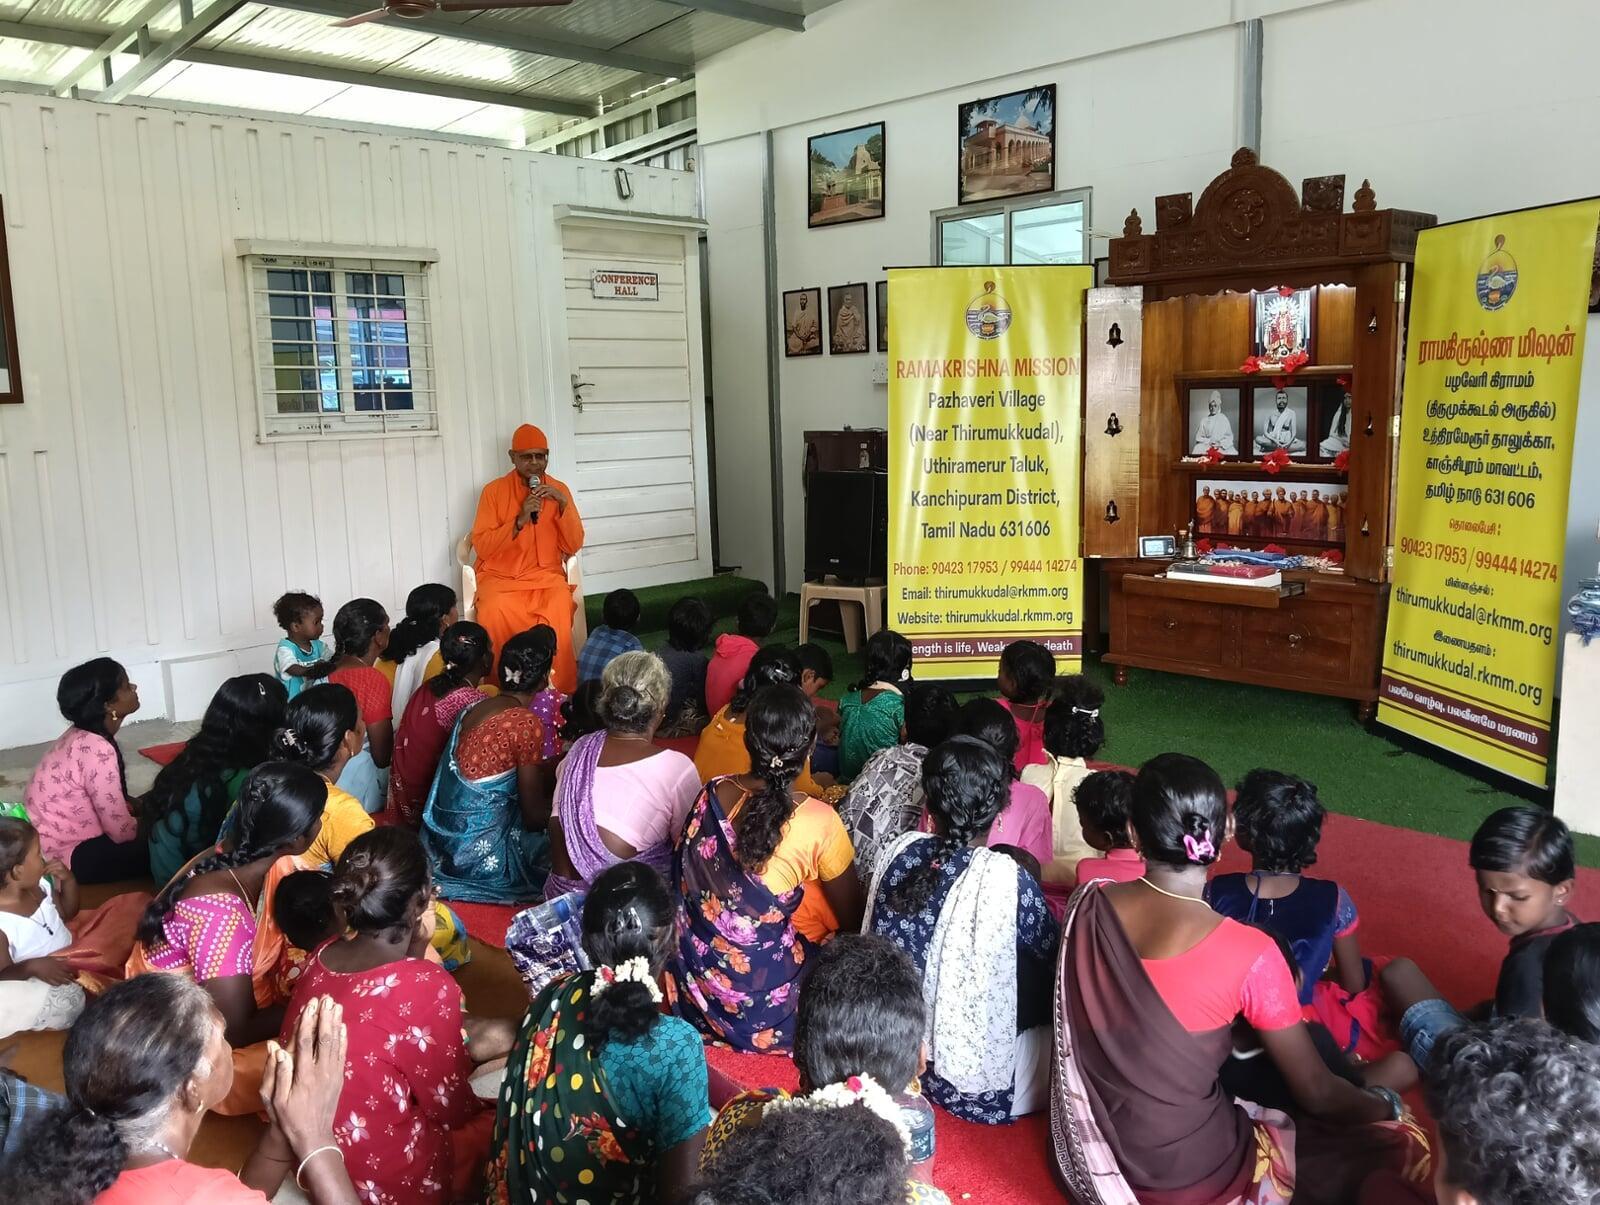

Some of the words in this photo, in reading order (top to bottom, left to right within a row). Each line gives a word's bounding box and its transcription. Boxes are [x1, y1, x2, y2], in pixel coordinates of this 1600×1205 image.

[595, 274, 656, 286] CONFERENCE
[614, 286, 639, 296] HALL
[1418, 330, 1515, 366] ராமகிருஷ்ண
[1518, 325, 1576, 365] மிஷன்
[896, 358, 1010, 378] RAMAKRISHNA
[1014, 357, 1080, 377] MISSION
[1445, 371, 1488, 393] பழவேரி
[1490, 370, 1535, 390] கிராமம்
[928, 391, 995, 409] Pazhaveri
[999, 390, 1046, 412] Village
[1426, 399, 1499, 420] (திருமுக்கூடல்
[1501, 400, 1556, 421] அருகில்)
[909, 422, 948, 446] (Near
[952, 420, 1064, 444] Thirumukkudal),
[923, 457, 1006, 475] Uthiramerur
[1010, 455, 1049, 475] Taluk,
[911, 490, 1002, 510] Kanchipuram
[1006, 488, 1060, 507] District,
[1425, 482, 1455, 504] தமிழ்
[1456, 487, 1482, 505] நாடு
[1484, 488, 1505, 505] 631
[1507, 490, 1536, 509] 606
[921, 522, 955, 538] Tamil
[960, 521, 995, 538] Nadu
[1000, 520, 1051, 537] 631606
[893, 562, 929, 575] Phone:
[932, 561, 964, 575] 90423
[967, 561, 998, 574] 17953
[1001, 560, 1008, 576] /
[1011, 560, 1042, 573] 99444
[1047, 559, 1077, 573] 14274
[1401, 536, 1432, 558] 90423
[1435, 543, 1467, 565] 17953
[1475, 550, 1517, 575] 99444
[1520, 558, 1558, 583] 14274
[902, 586, 932, 600] Email:
[935, 584, 1068, 600] thirumukkudal@rkmm.org
[897, 611, 943, 625] Website:
[946, 608, 1073, 624] thirumukkudal.rkmm.org
[1396, 586, 1553, 645] thirumukkudal@rkmm.org
[912, 642, 941, 657] ength
[944, 642, 953, 653] is
[955, 641, 975, 655] life,
[1043, 639, 1073, 651] death
[1393, 640, 1543, 706] thirumukkudal.rkmm.org
